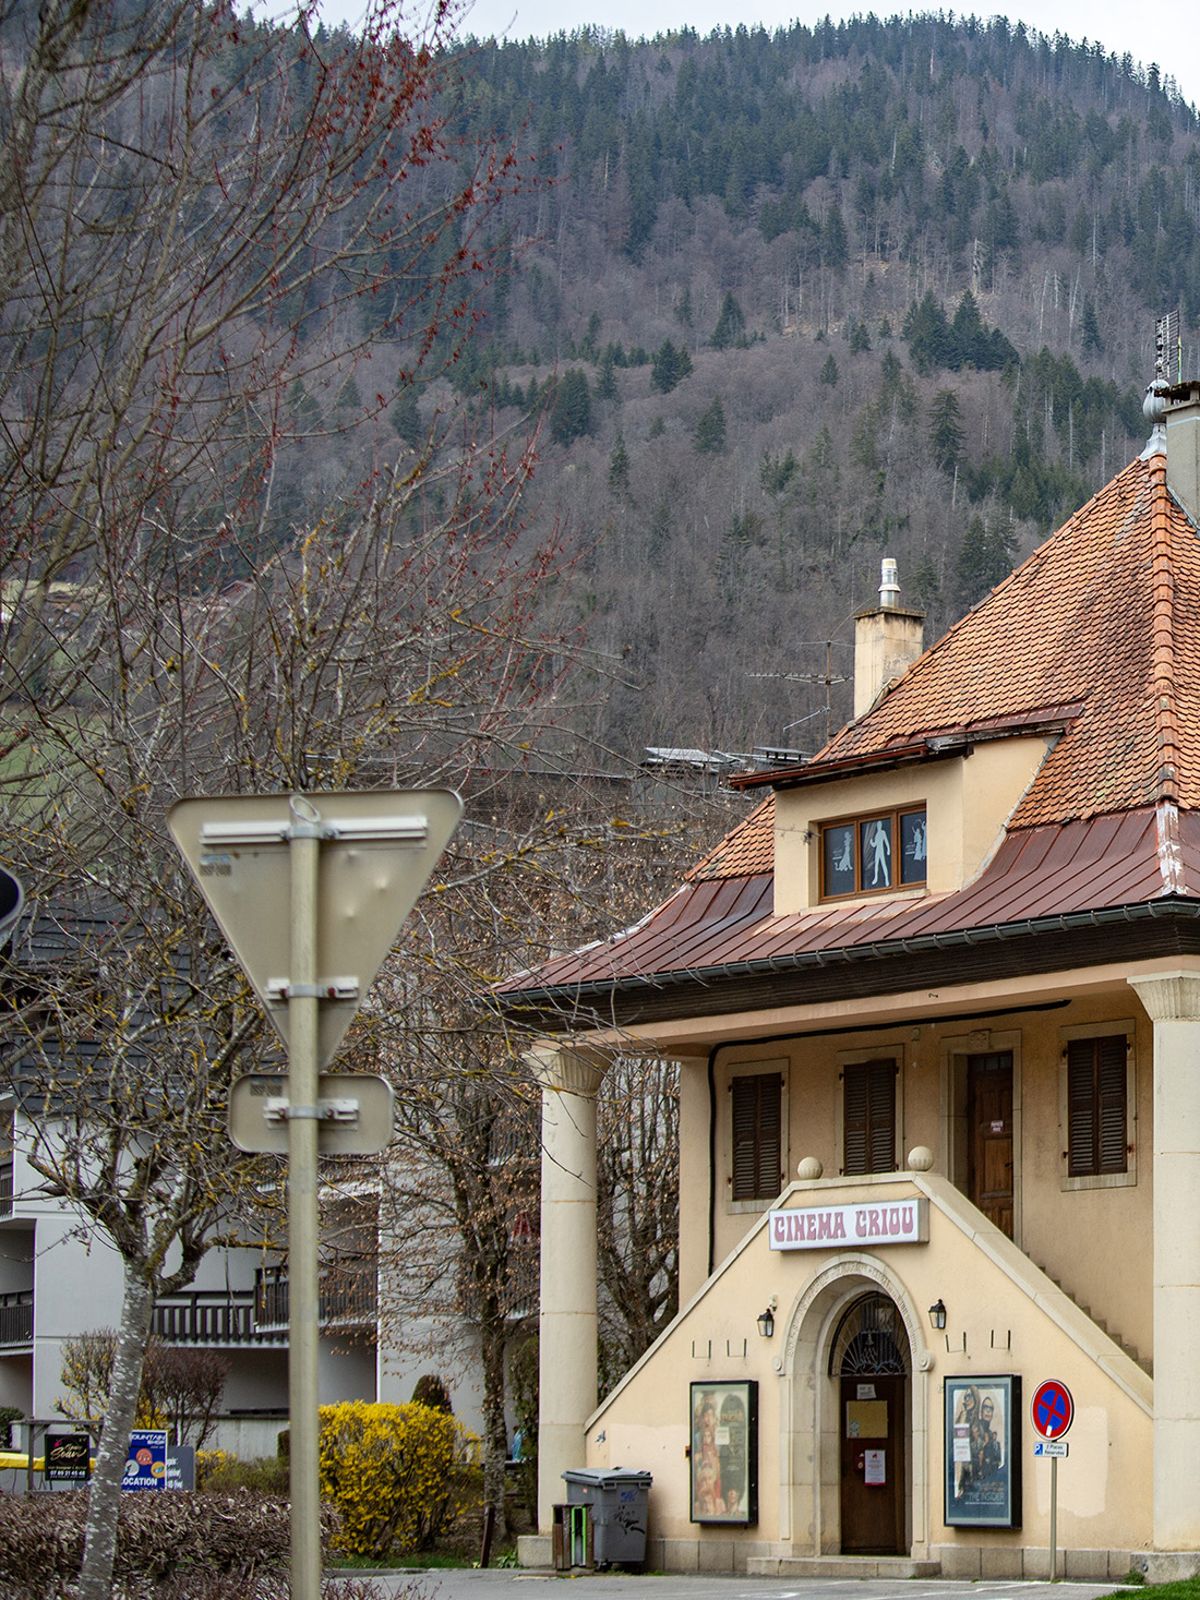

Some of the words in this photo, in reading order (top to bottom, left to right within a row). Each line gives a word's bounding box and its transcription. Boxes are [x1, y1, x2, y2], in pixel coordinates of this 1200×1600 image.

[774, 1211, 847, 1242] CINEMA
[855, 1206, 914, 1238] CRIOU
[130, 1433, 166, 1441] OUNTAIN
